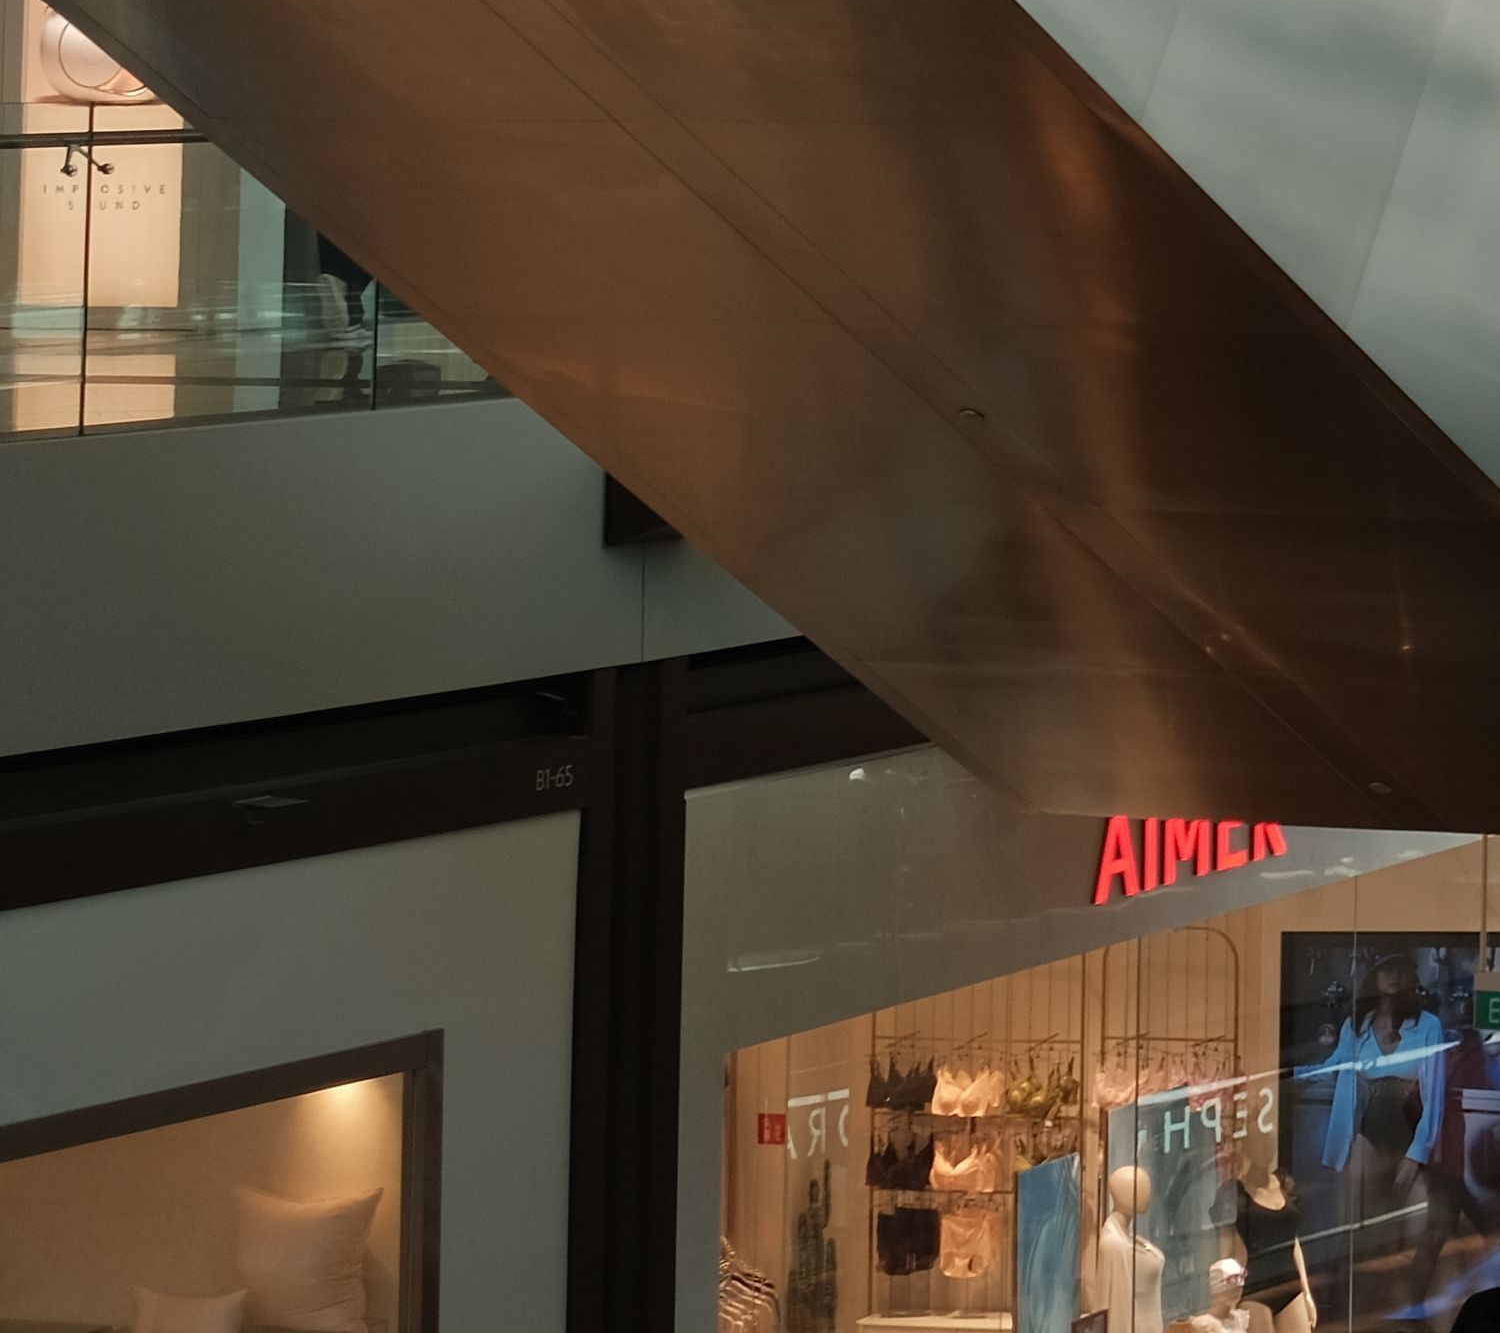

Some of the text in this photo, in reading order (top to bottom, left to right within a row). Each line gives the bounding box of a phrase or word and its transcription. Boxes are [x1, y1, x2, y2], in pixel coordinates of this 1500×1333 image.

[43, 184, 166, 194] IMPOSIVE
[68, 200, 141, 210] SUND
[535, 764, 574, 791] B1-65
